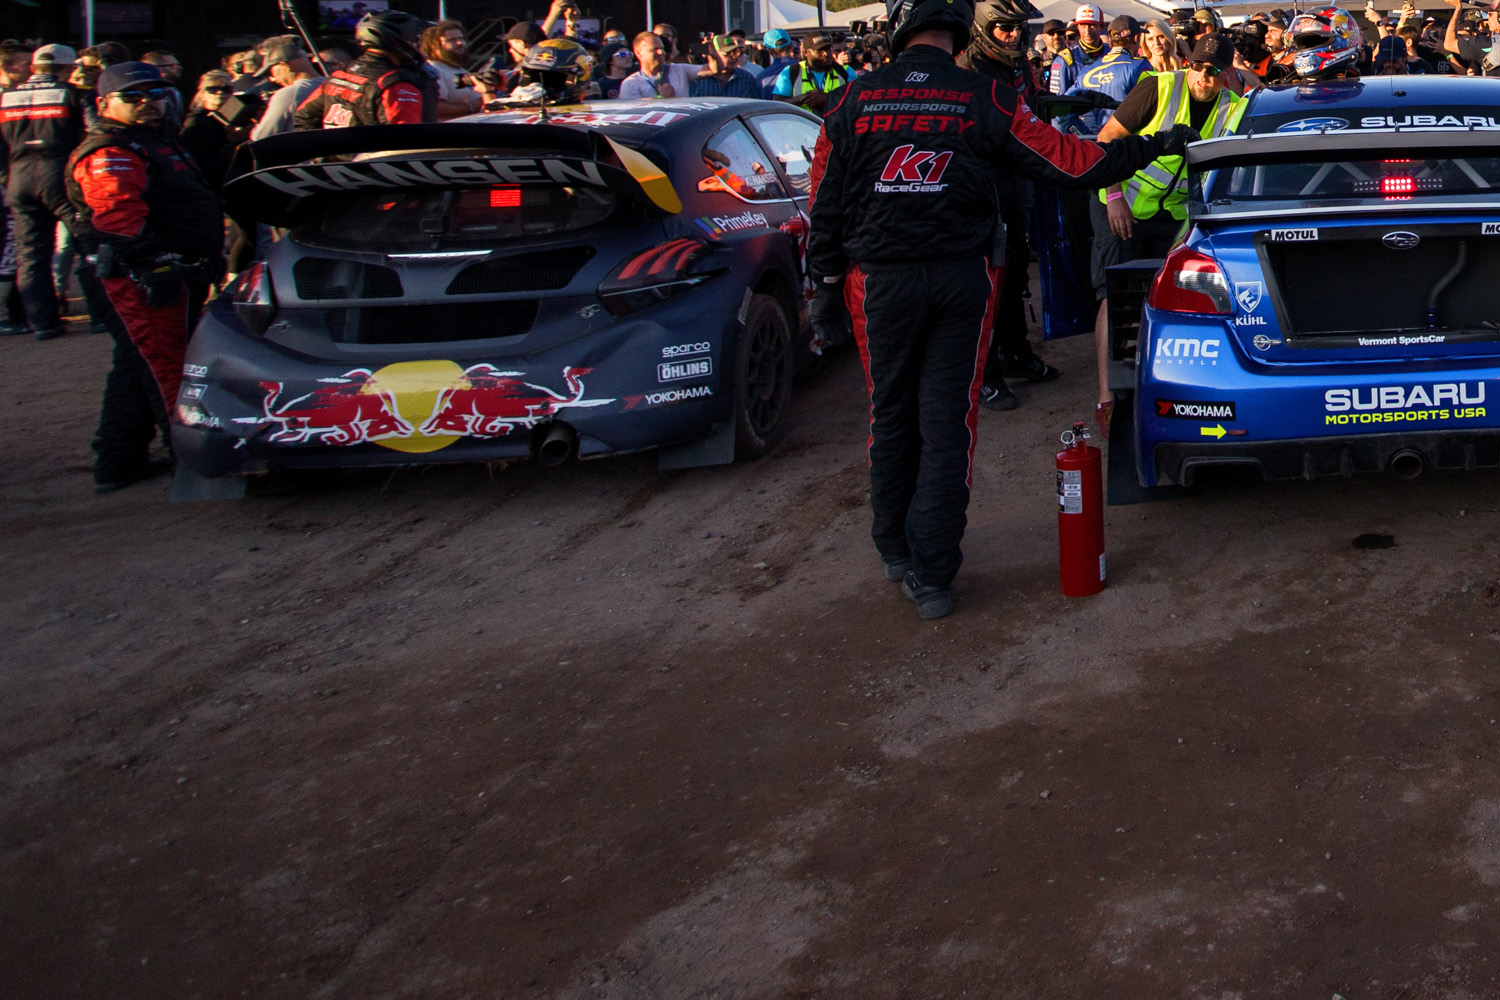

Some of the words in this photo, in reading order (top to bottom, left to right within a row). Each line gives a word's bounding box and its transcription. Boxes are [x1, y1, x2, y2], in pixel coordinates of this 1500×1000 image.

[905, 71, 930, 82] K1
[16, 82, 56, 90] KEVIN
[857, 88, 974, 103] RESPONSE
[863, 103, 967, 114] MOTORSPORTS
[854, 115, 976, 134] SAFETY
[880, 144, 953, 184] K1
[253, 159, 607, 197] HANSEN
[874, 182, 949, 193] RaceGear
[713, 211, 770, 232] PrimeKey
[1274, 230, 1317, 241] MOTUL
[1236, 315, 1267, 326] KÜHL
[1155, 338, 1220, 358] KMC
[1358, 336, 1397, 346] Vermont
[1399, 334, 1445, 346] SportsCar
[662, 341, 710, 358] sparco
[661, 361, 709, 379] ÖHLINS
[645, 386, 712, 405] YOKOHAMA
[1325, 381, 1486, 411] SUBARU
[1173, 404, 1233, 418] YOKOHAMA
[1325, 409, 1450, 425] MOTORSPORTS
[1454, 407, 1486, 419] USA
